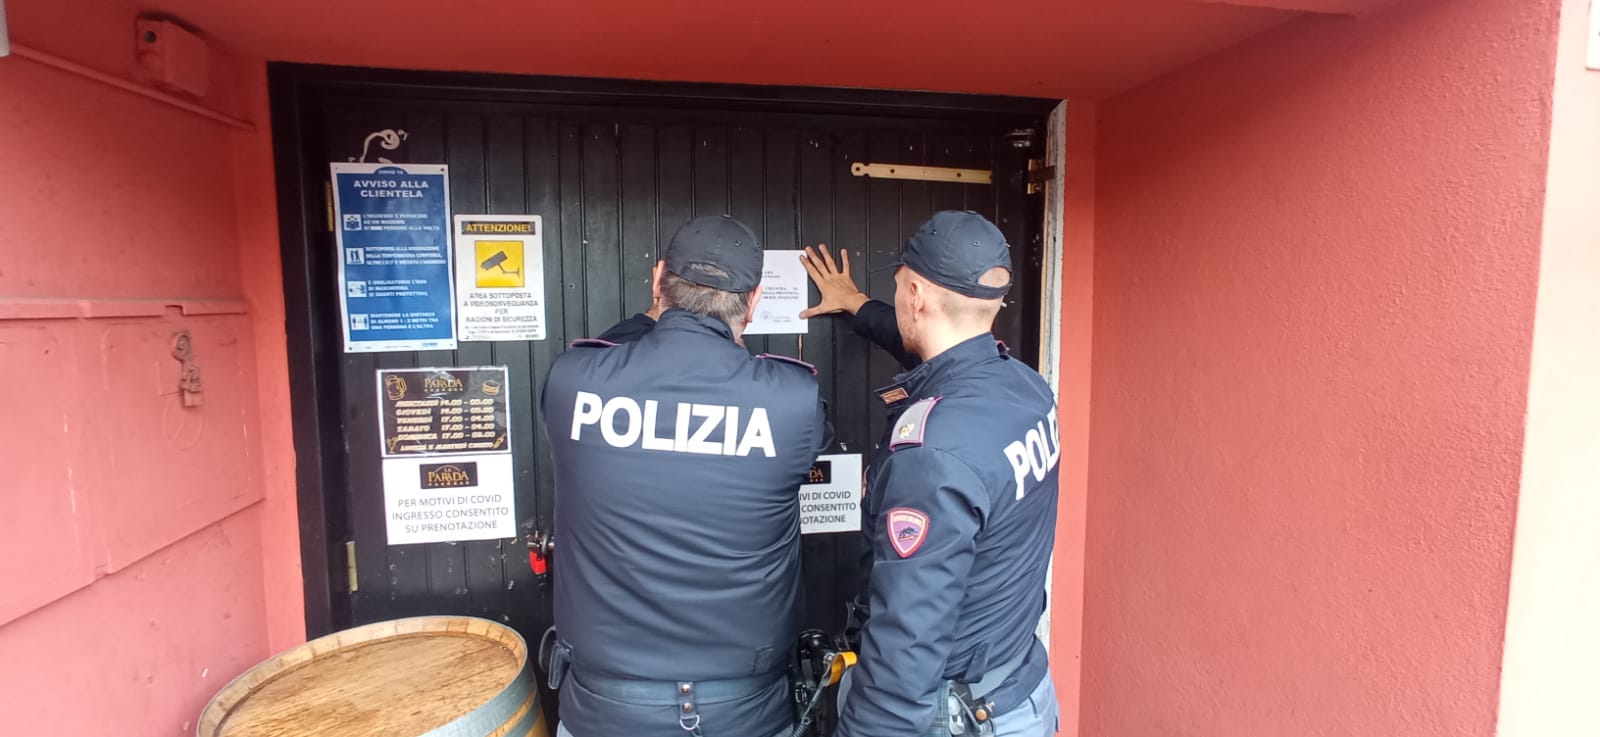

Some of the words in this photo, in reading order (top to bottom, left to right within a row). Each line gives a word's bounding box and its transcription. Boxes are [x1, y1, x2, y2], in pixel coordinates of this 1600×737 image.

[353, 180, 396, 188] AVVISO
[400, 180, 429, 188] ALLA
[360, 190, 424, 198] CLIENTELA
[466, 224, 532, 232] ATTENZIONE!
[570, 391, 777, 458] POLIZIA
[1003, 402, 1060, 500] POLI
[428, 471, 469, 482] PARADA
[398, 499, 417, 507] PER
[419, 497, 455, 506] MOTIVI
[458, 496, 468, 504] DI
[470, 494, 502, 504] COVID
[800, 492, 810, 501] IVI
[812, 492, 821, 500] DI
[823, 491, 851, 499] COVID
[801, 502, 856, 512] CONSENTITO
[392, 510, 443, 521] INGRESSO
[445, 507, 509, 518] CONSENTITO
[800, 515, 846, 525] OTAZIONE
[405, 524, 419, 533] SU
[421, 520, 498, 532] PRENOTAZIONE
